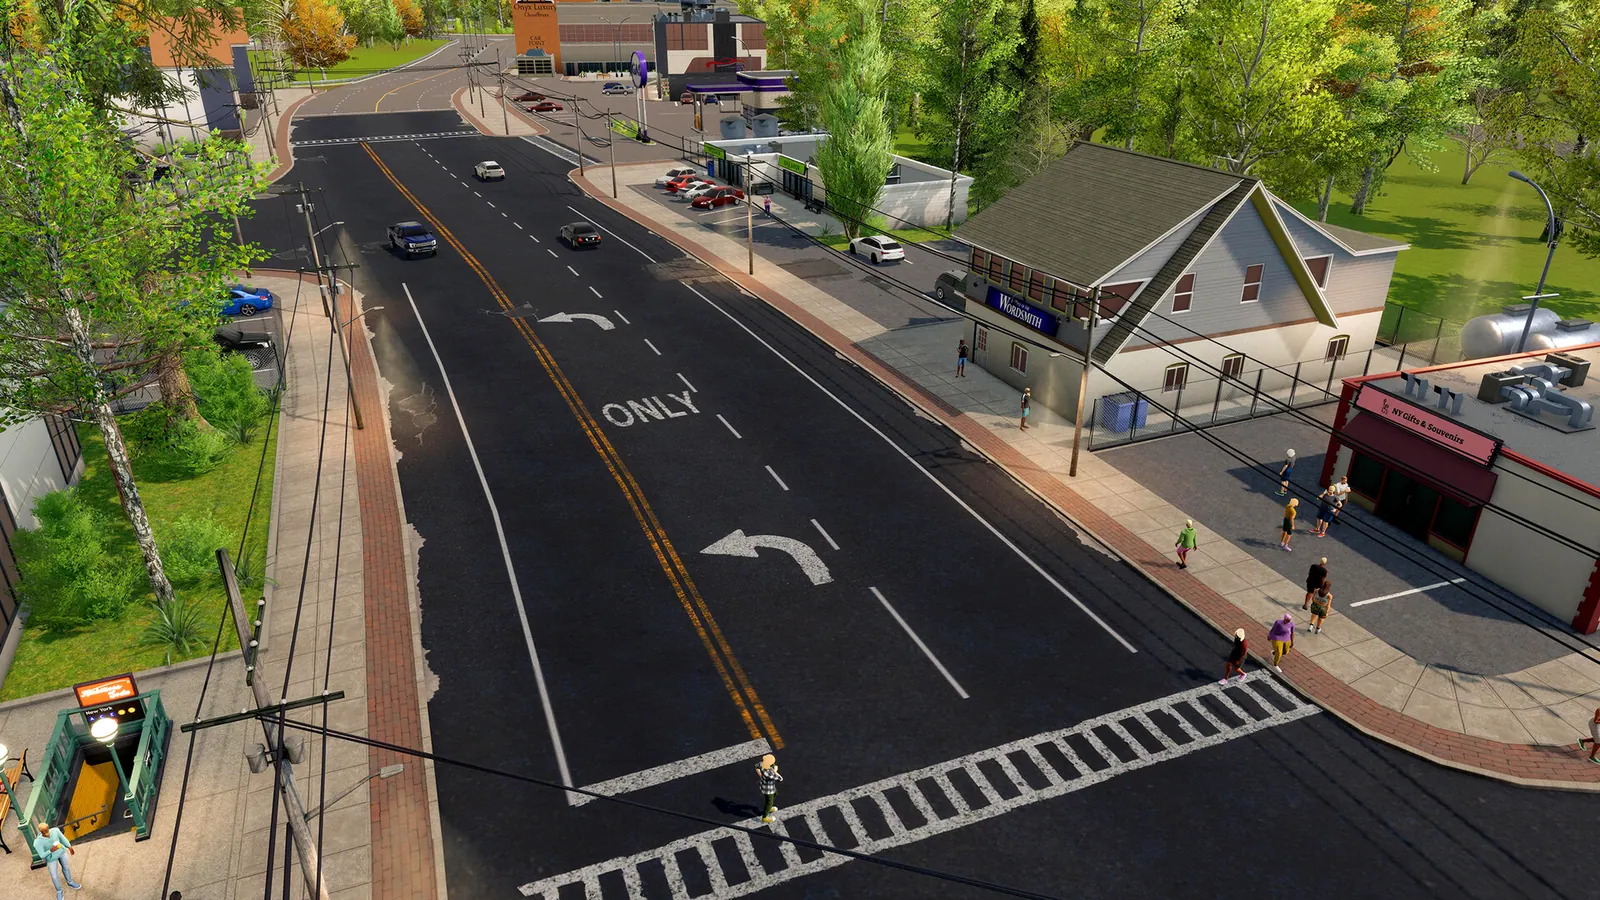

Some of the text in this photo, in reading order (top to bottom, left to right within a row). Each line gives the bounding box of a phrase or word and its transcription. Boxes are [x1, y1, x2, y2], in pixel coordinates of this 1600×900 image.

[514, 3, 557, 12] Onyx Luxury
[602, 391, 700, 427] ONLY
[1392, 407, 1465, 445] NY Gifts & Souvenirs
